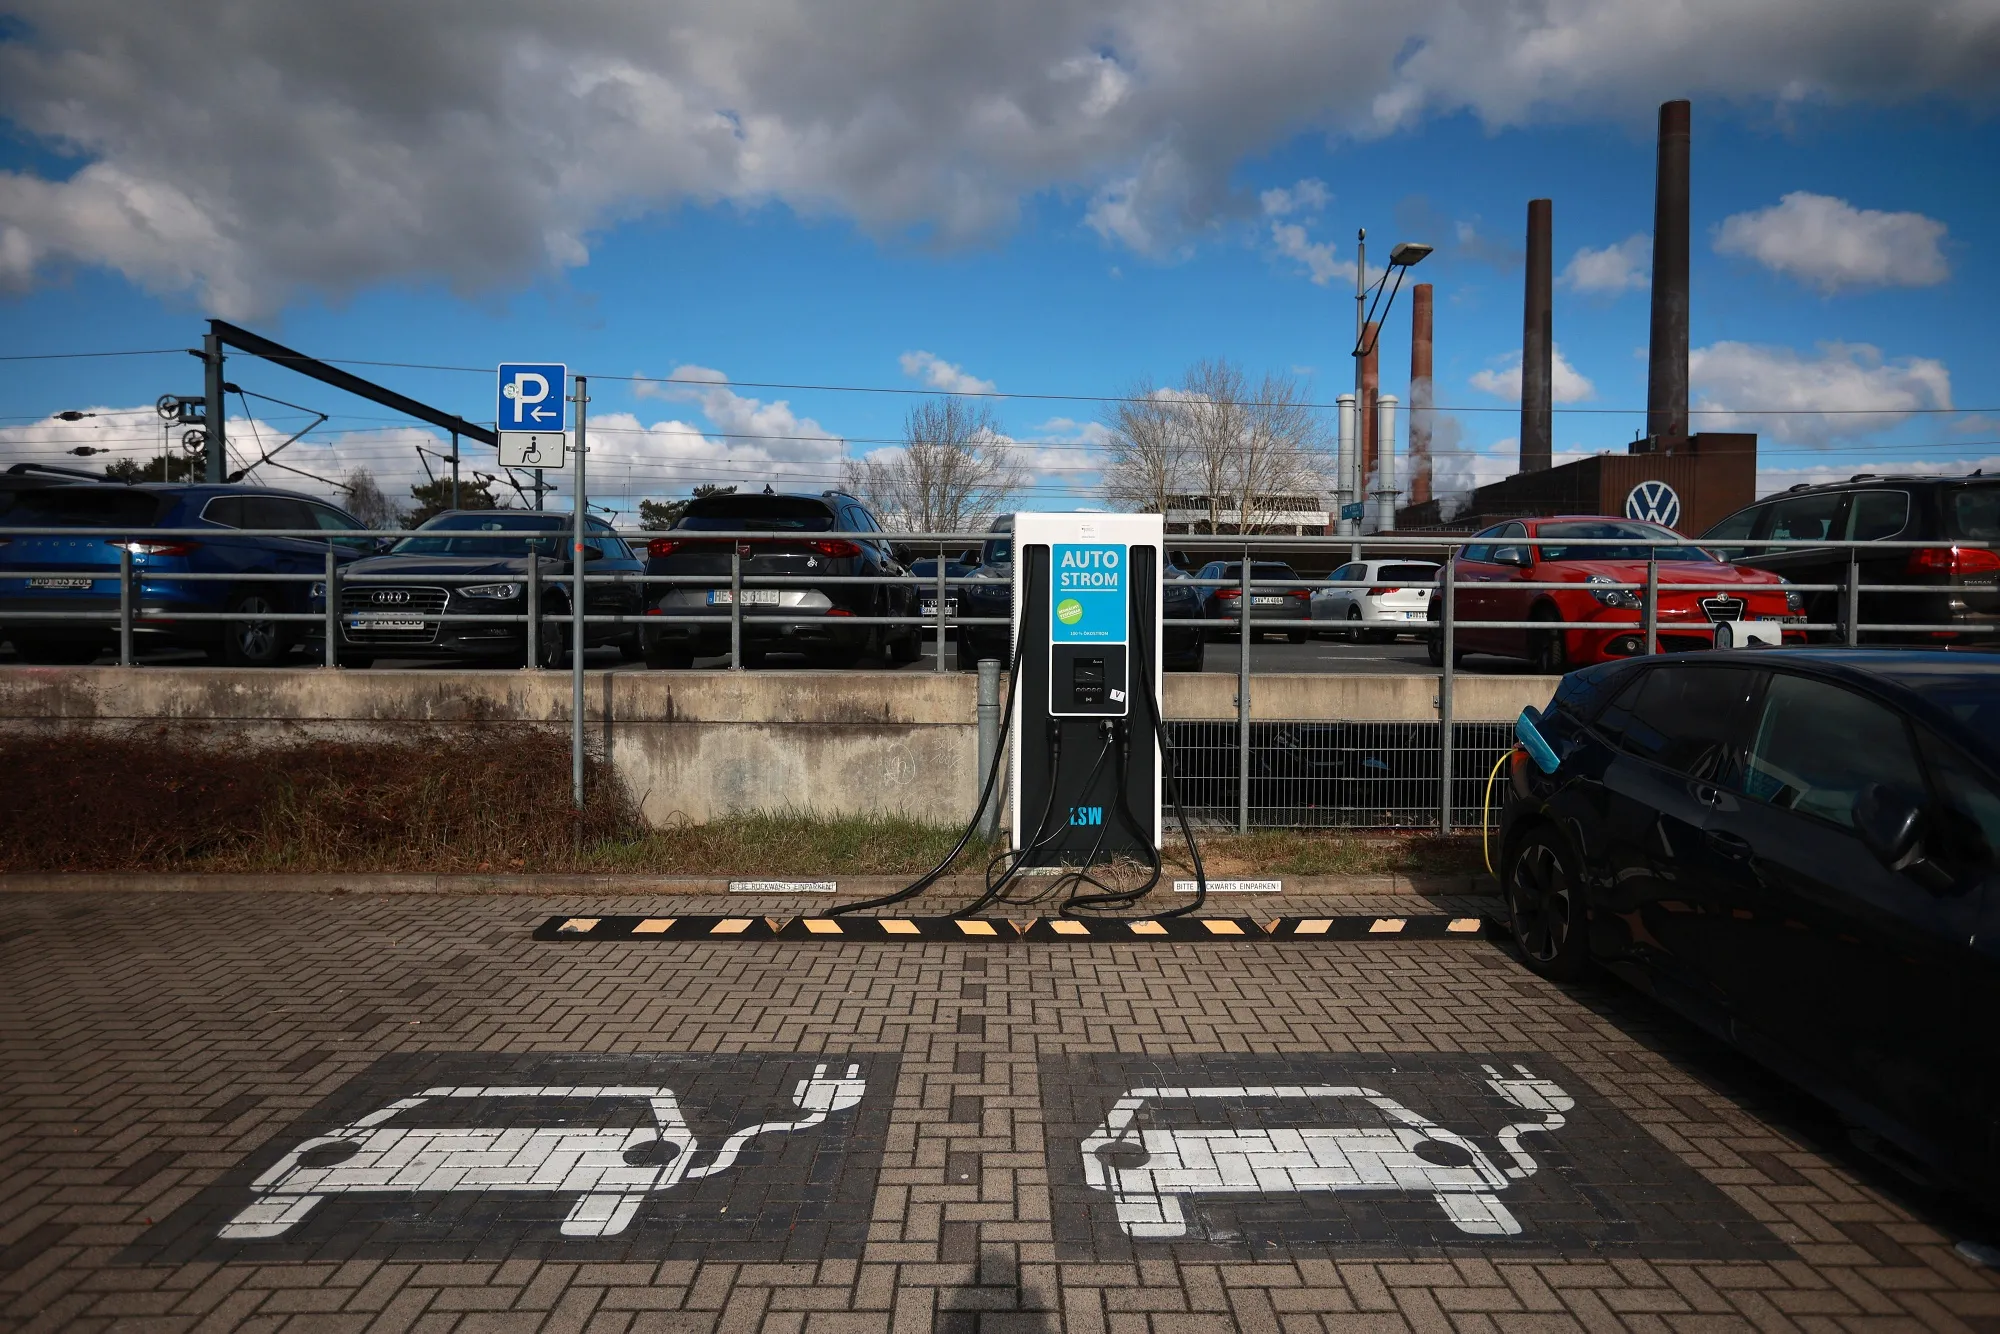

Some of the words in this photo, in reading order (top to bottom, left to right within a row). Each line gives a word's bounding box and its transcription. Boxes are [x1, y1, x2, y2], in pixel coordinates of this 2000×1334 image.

[514, 373, 550, 423] P
[1061, 550, 1119, 568] AUTO
[1061, 572, 1118, 586] STROM
[1070, 806, 1102, 825] LSW
[1197, 882, 1237, 890] CKWÄRTS
